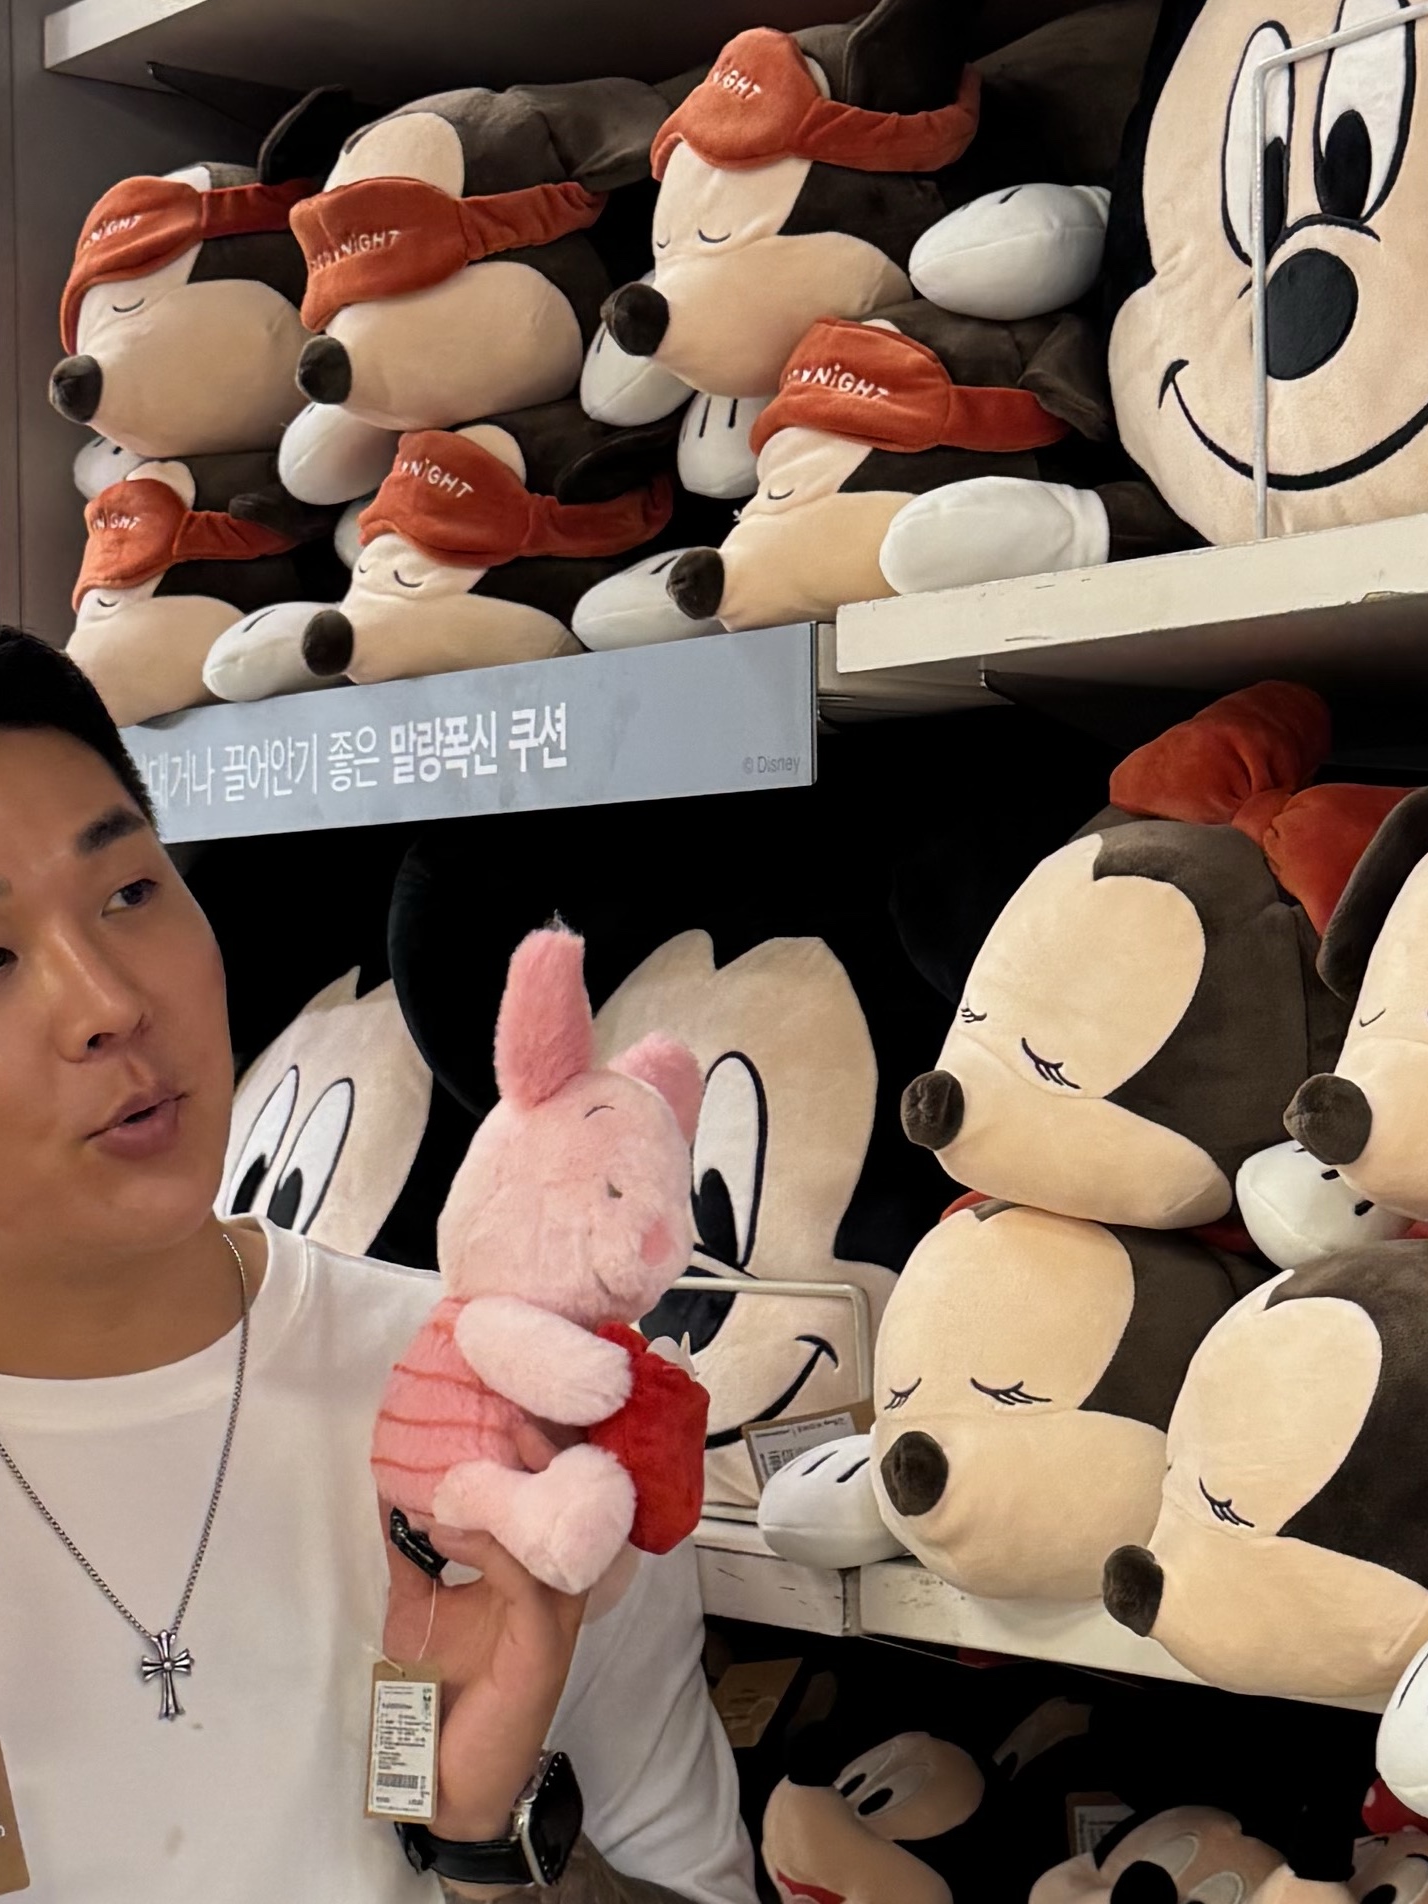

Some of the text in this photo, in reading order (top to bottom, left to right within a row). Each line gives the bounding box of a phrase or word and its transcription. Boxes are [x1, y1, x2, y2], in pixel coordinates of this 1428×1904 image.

[139, 701, 569, 809] 대거나 끌어안기 좋은 말랑폭신 쿠션
[757, 752, 802, 776] Disney
